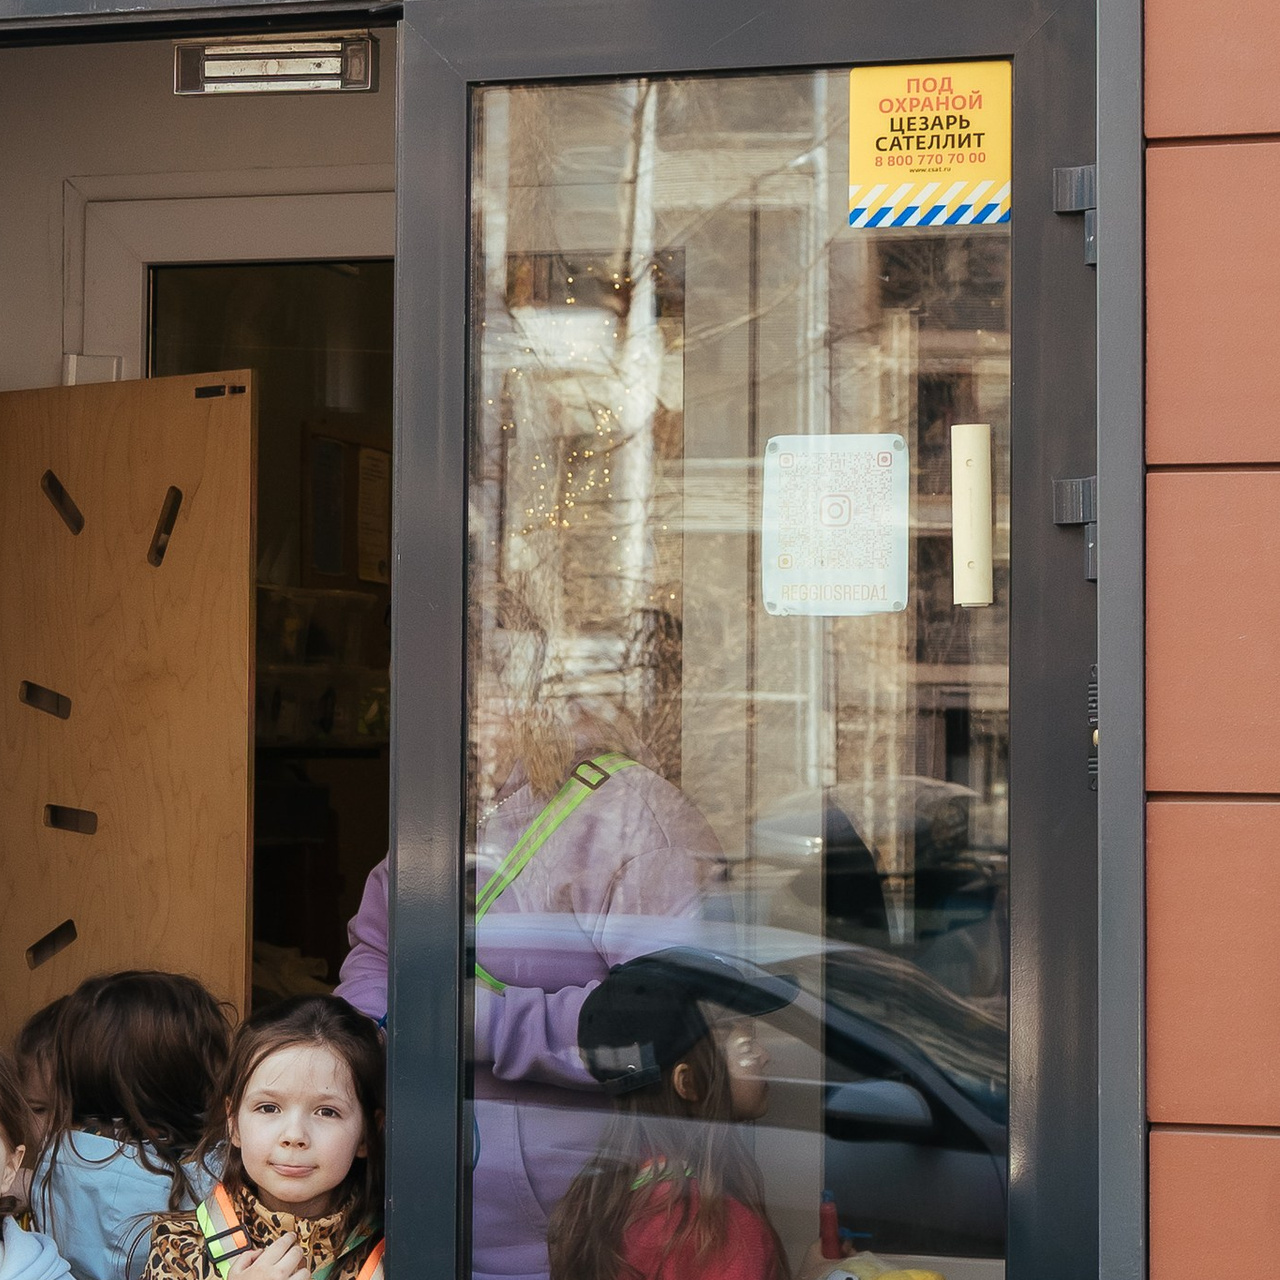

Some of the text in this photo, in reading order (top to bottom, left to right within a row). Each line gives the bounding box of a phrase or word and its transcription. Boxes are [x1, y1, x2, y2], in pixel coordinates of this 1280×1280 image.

[907, 76, 953, 95] ПОД
[878, 90, 983, 114] ОХРАНОЙ
[890, 114, 971, 135] ЦЕЗАРЬ
[875, 132, 986, 152] САТЕЛЛИТ
[874, 152, 986, 167] 8 800 770 70 00
[781, 584, 888, 601] REGGIOSREDA1
